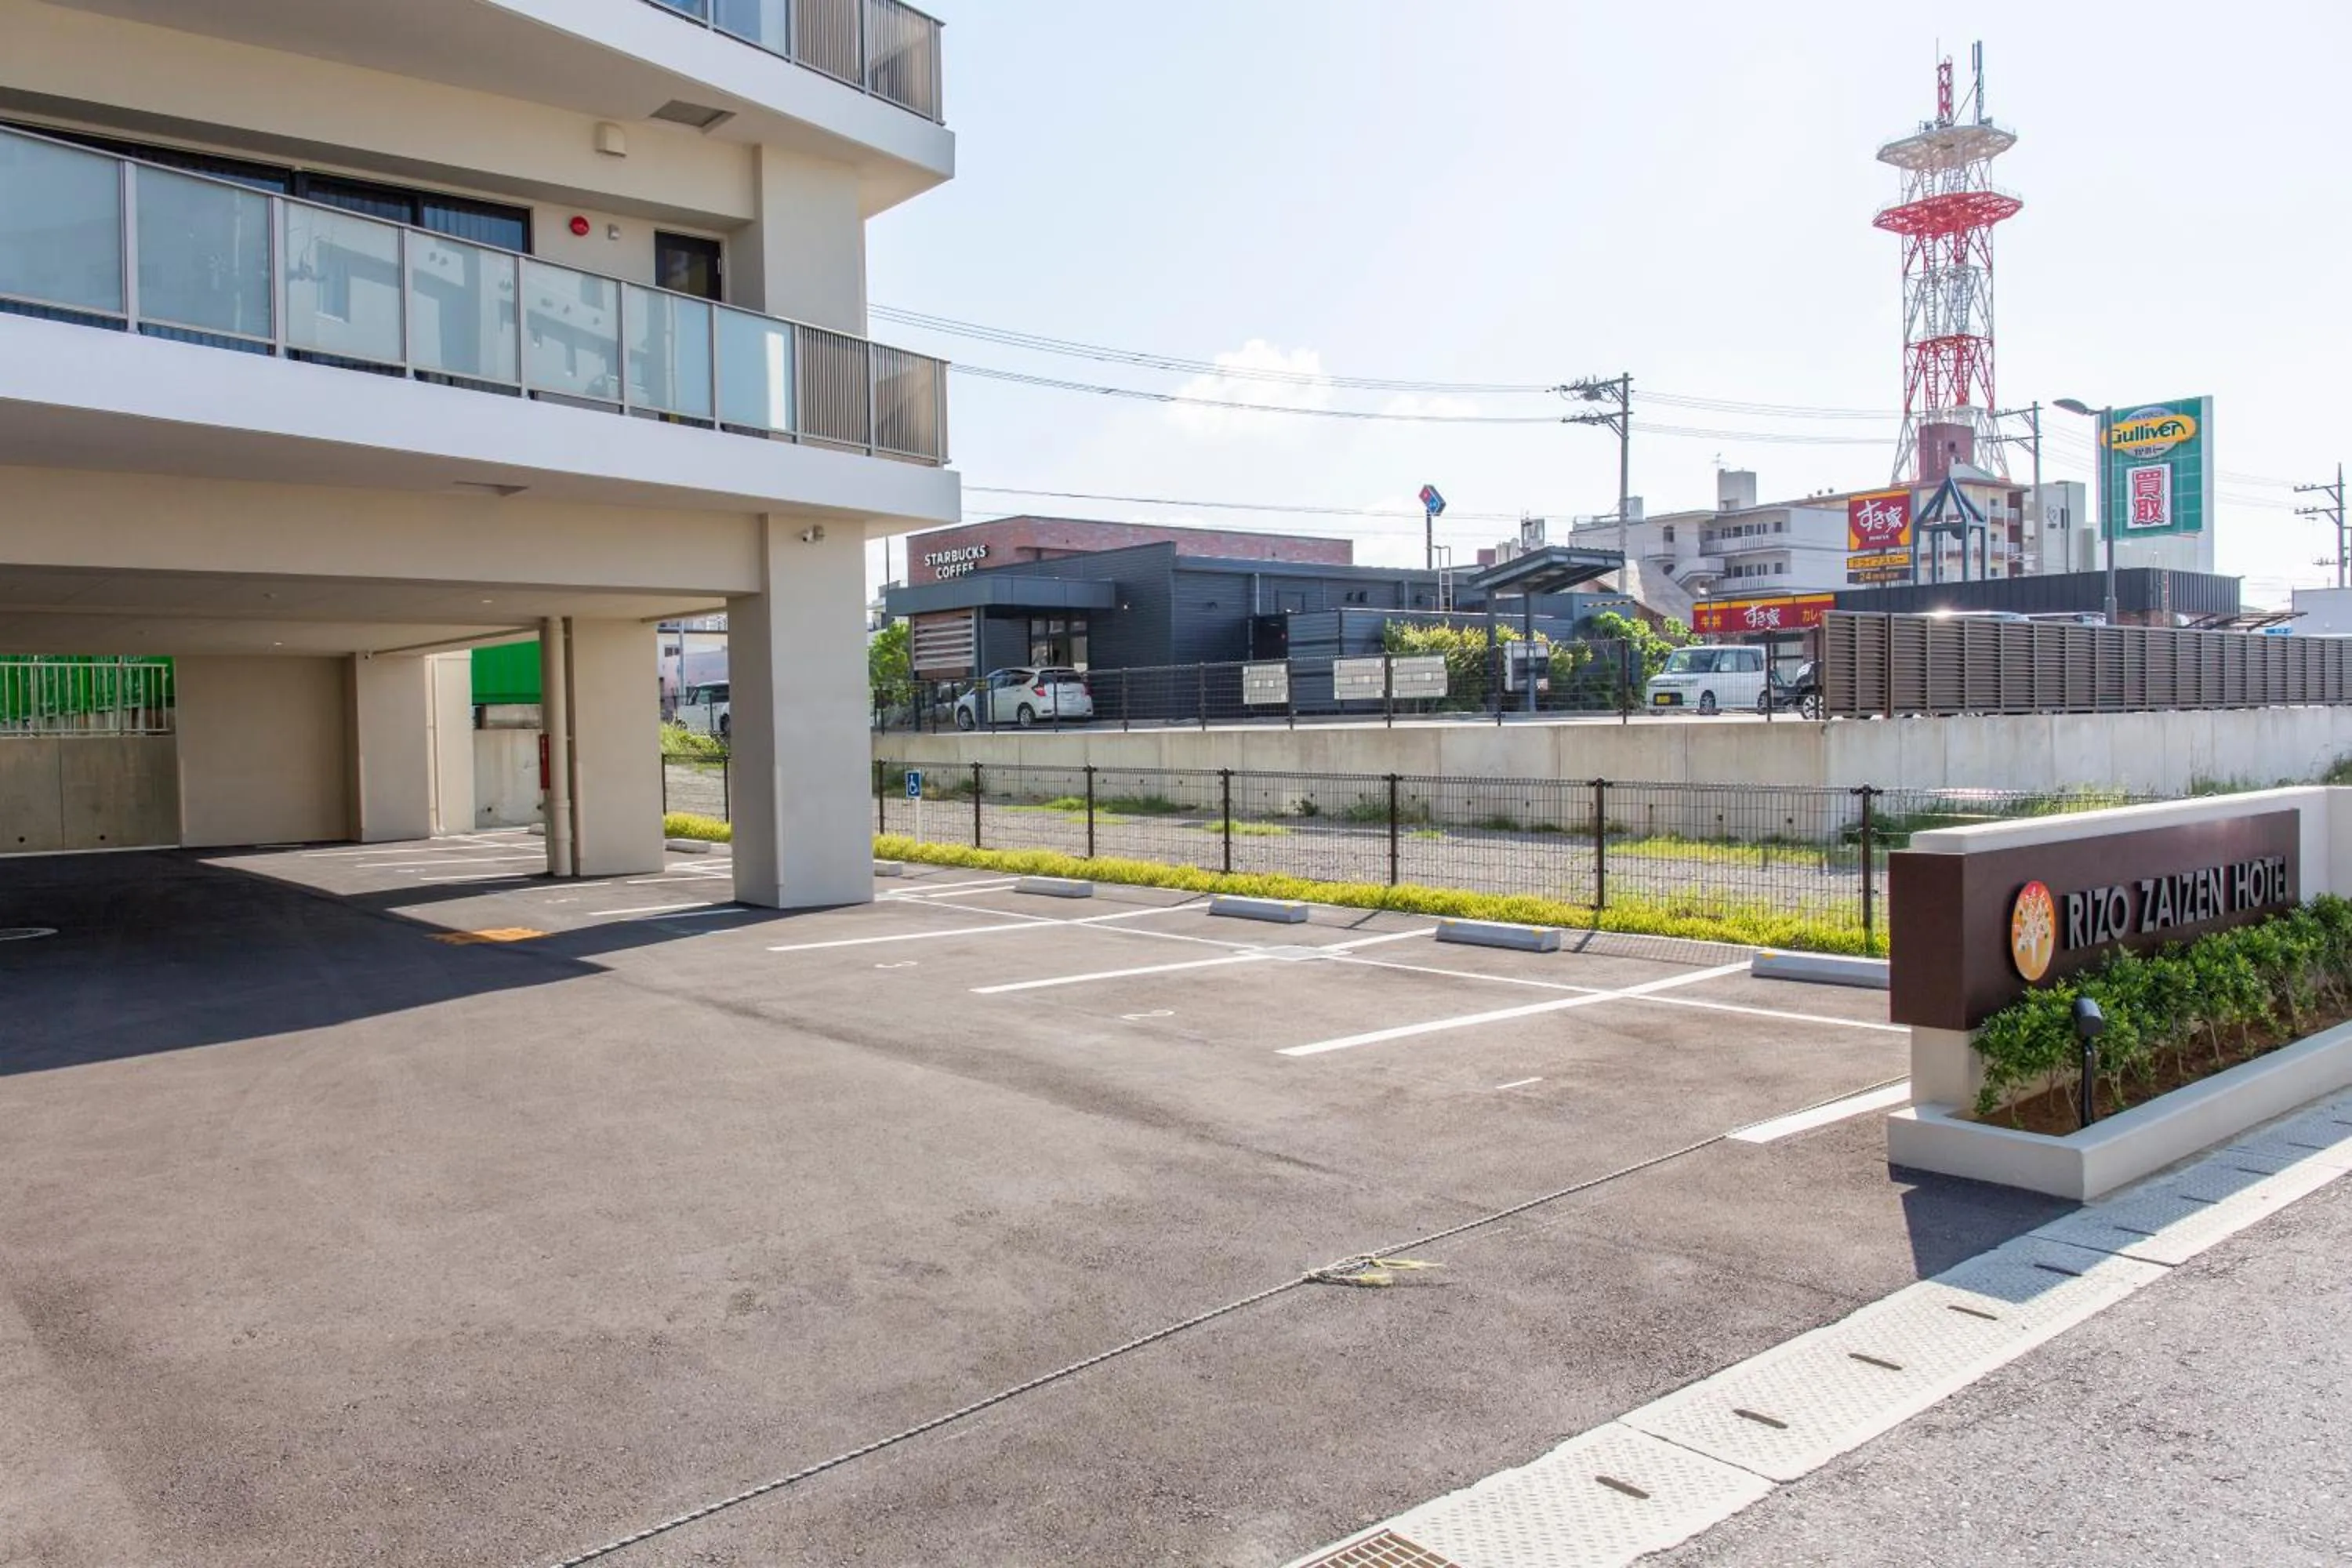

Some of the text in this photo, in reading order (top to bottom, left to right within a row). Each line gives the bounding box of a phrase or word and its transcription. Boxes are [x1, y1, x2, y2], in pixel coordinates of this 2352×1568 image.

[2112, 419, 2186, 444] Gulliver
[2132, 467, 2164, 524] 買取
[1856, 499, 1904, 533] すき家
[924, 545, 987, 567] STARBUCKS
[935, 561, 975, 579] COFFEE
[1700, 614, 1722, 628] 牛丼
[1743, 603, 1781, 628] すき家
[2068, 856, 2289, 949] RIZO ZAIZEN HOTEL
